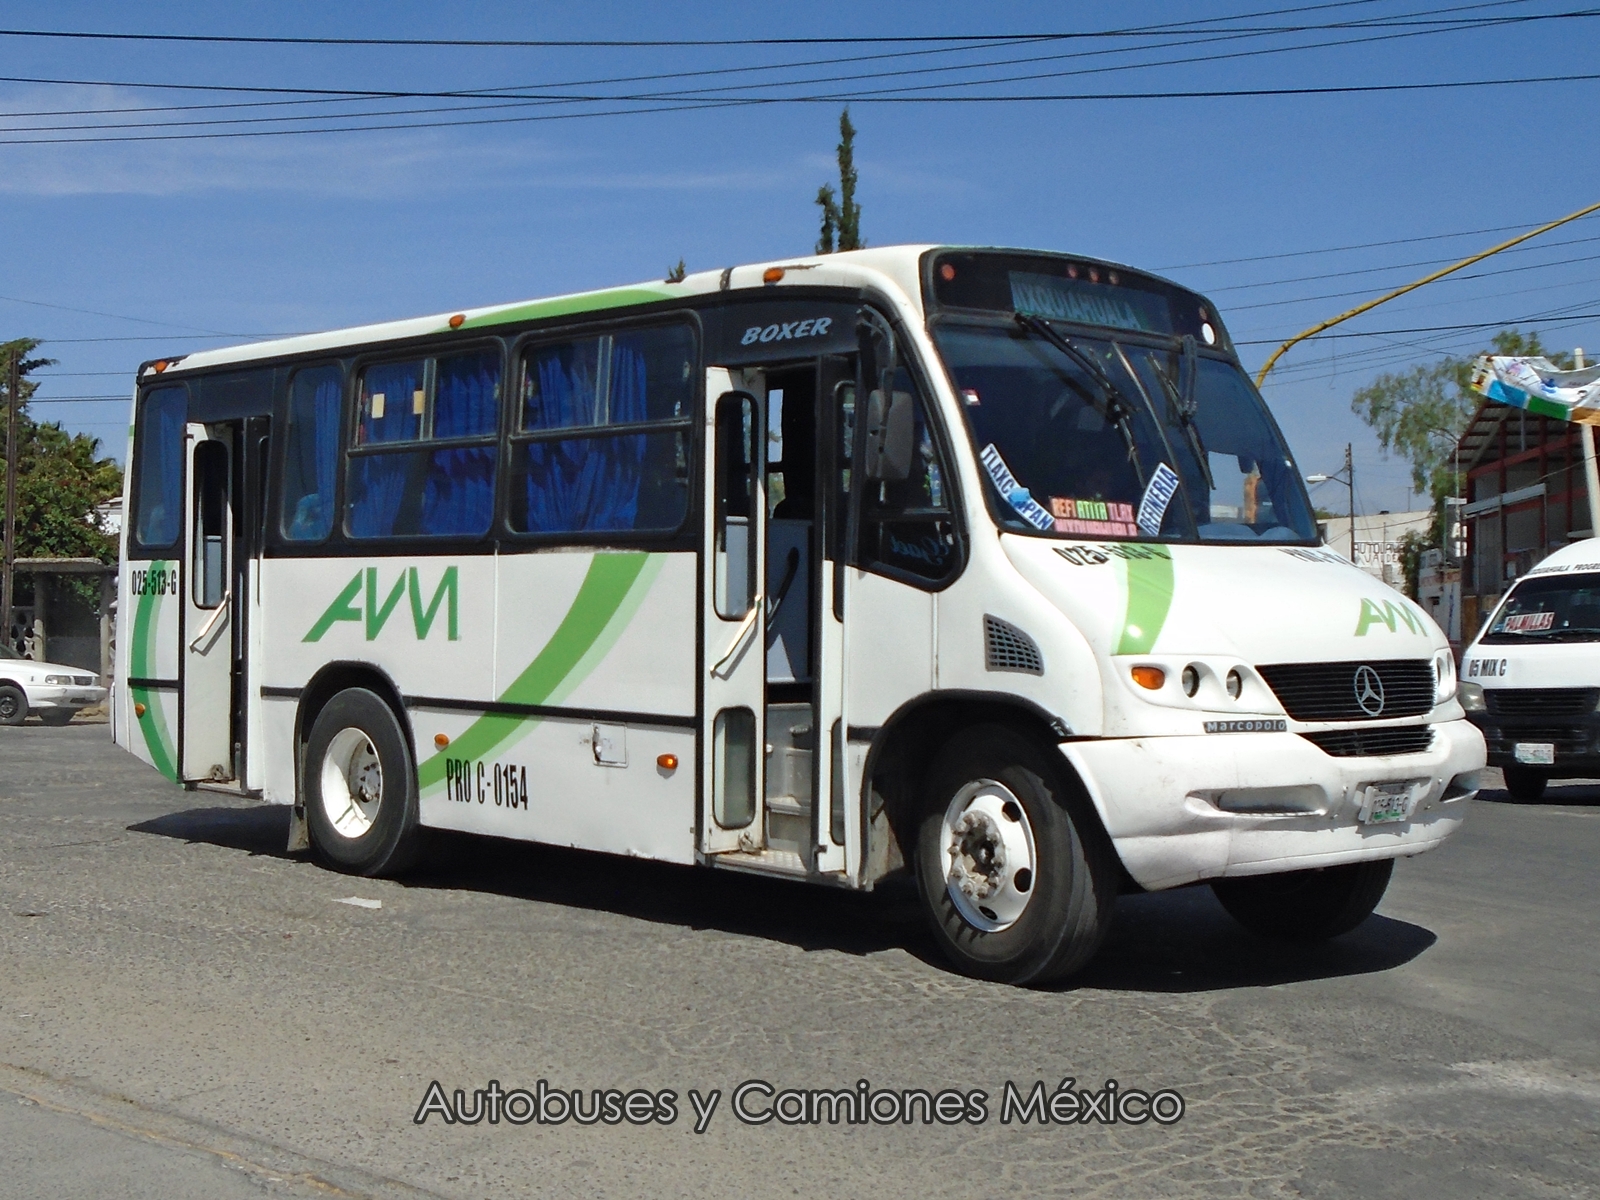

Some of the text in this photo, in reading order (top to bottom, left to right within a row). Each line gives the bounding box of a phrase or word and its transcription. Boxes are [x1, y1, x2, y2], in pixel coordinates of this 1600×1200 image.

[741, 317, 832, 346] BOXER
[982, 447, 1053, 529] TLAXCAPAN
[1138, 464, 1178, 537] REFINERIA
[132, 570, 177, 596] 025-513-G
[301, 566, 459, 643] AVM
[1504, 613, 1554, 632] PALMILLAS
[1480, 659, 1499, 677] MIX
[1499, 658, 1507, 677] C
[1207, 720, 1287, 733] Marcopolo
[446, 758, 528, 811] PRO C-0154
